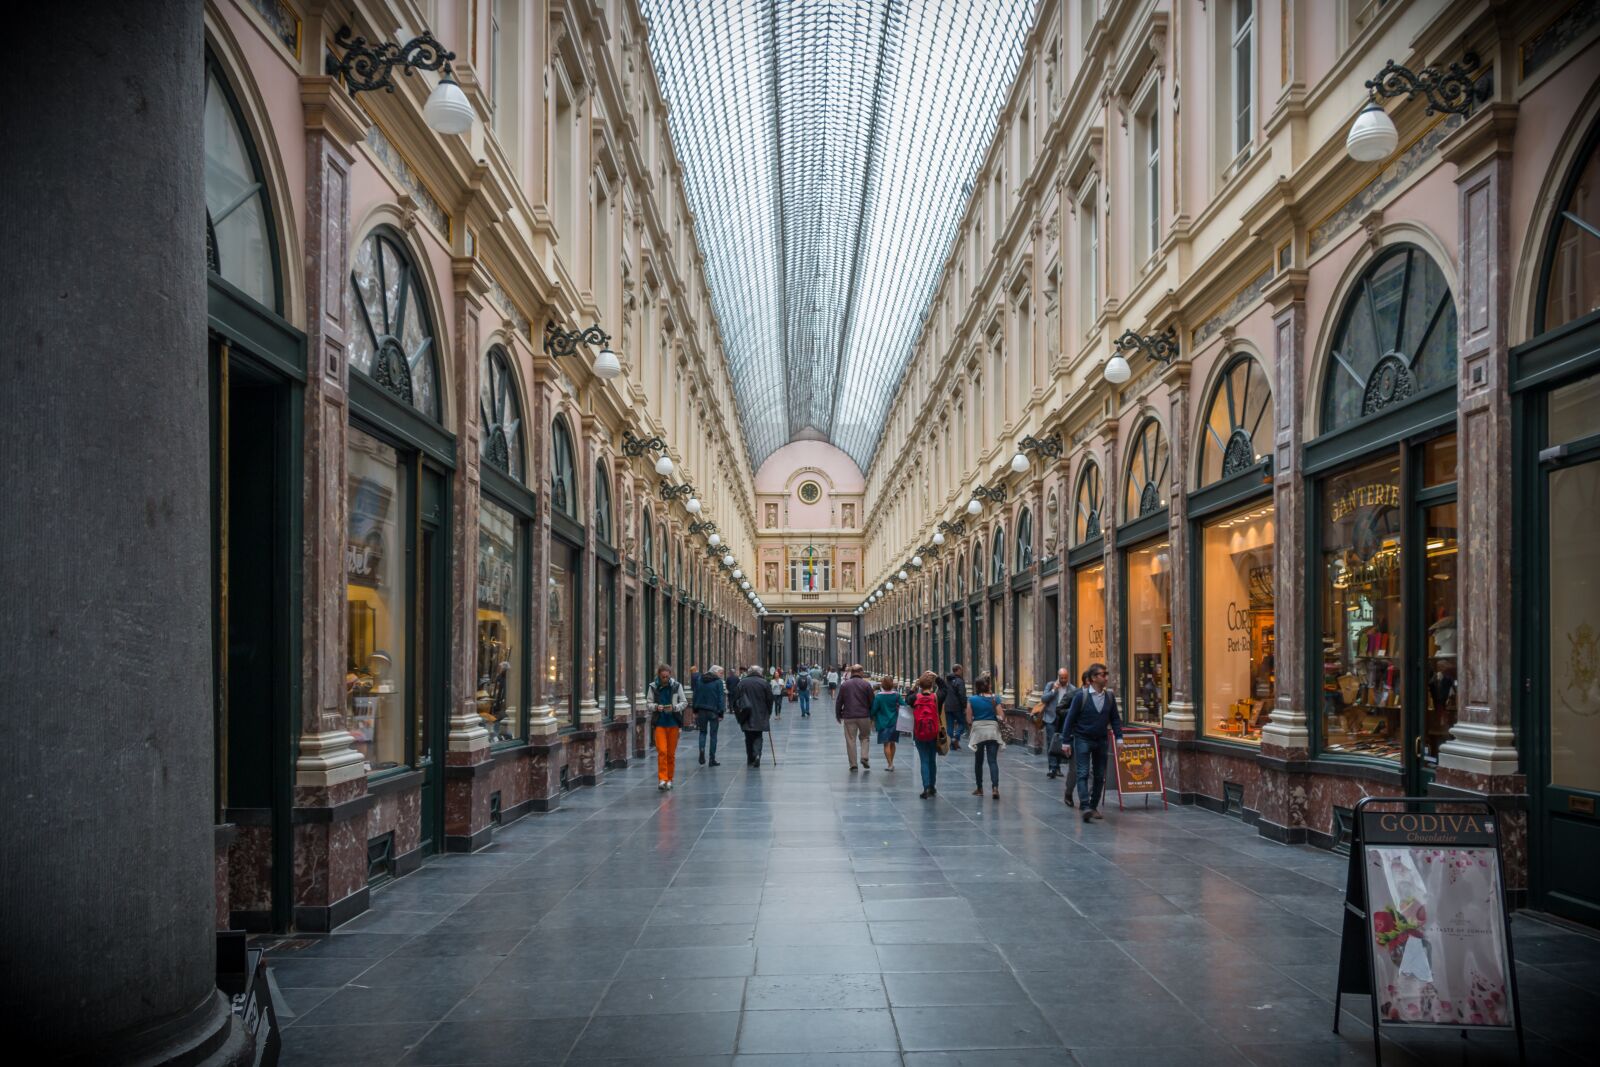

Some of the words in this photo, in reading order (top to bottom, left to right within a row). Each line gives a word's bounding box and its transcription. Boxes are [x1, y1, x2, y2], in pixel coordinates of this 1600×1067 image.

[1330, 484, 1400, 523] GANTERIE
[1380, 814, 1482, 833] GODIVA
[1406, 833, 1457, 843] Chocolatier
